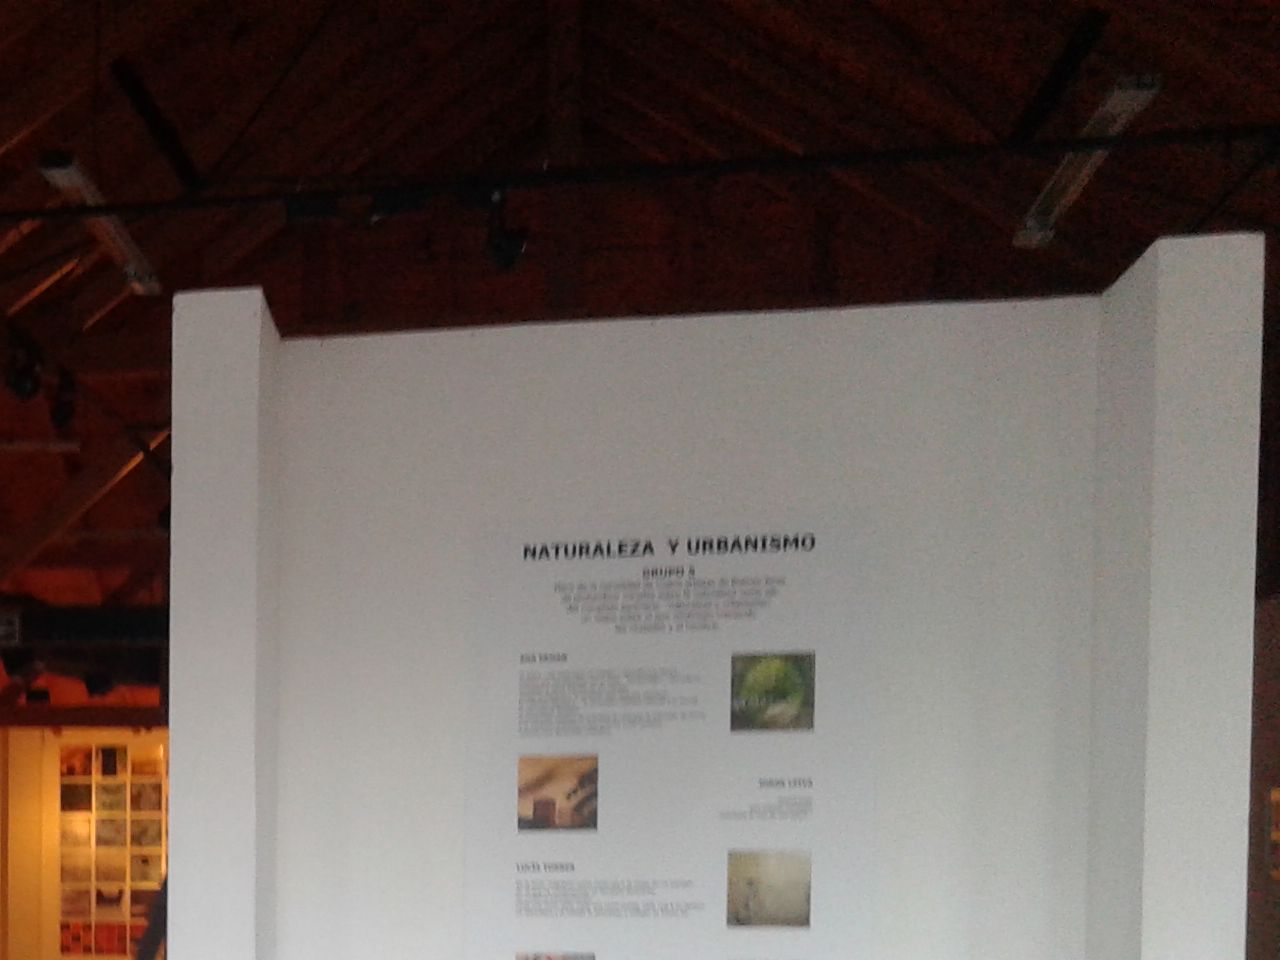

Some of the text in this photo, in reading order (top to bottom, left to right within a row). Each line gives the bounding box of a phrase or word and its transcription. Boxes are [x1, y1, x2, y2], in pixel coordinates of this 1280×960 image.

[523, 532, 816, 561] NATURALEZA Y URBANISMO
